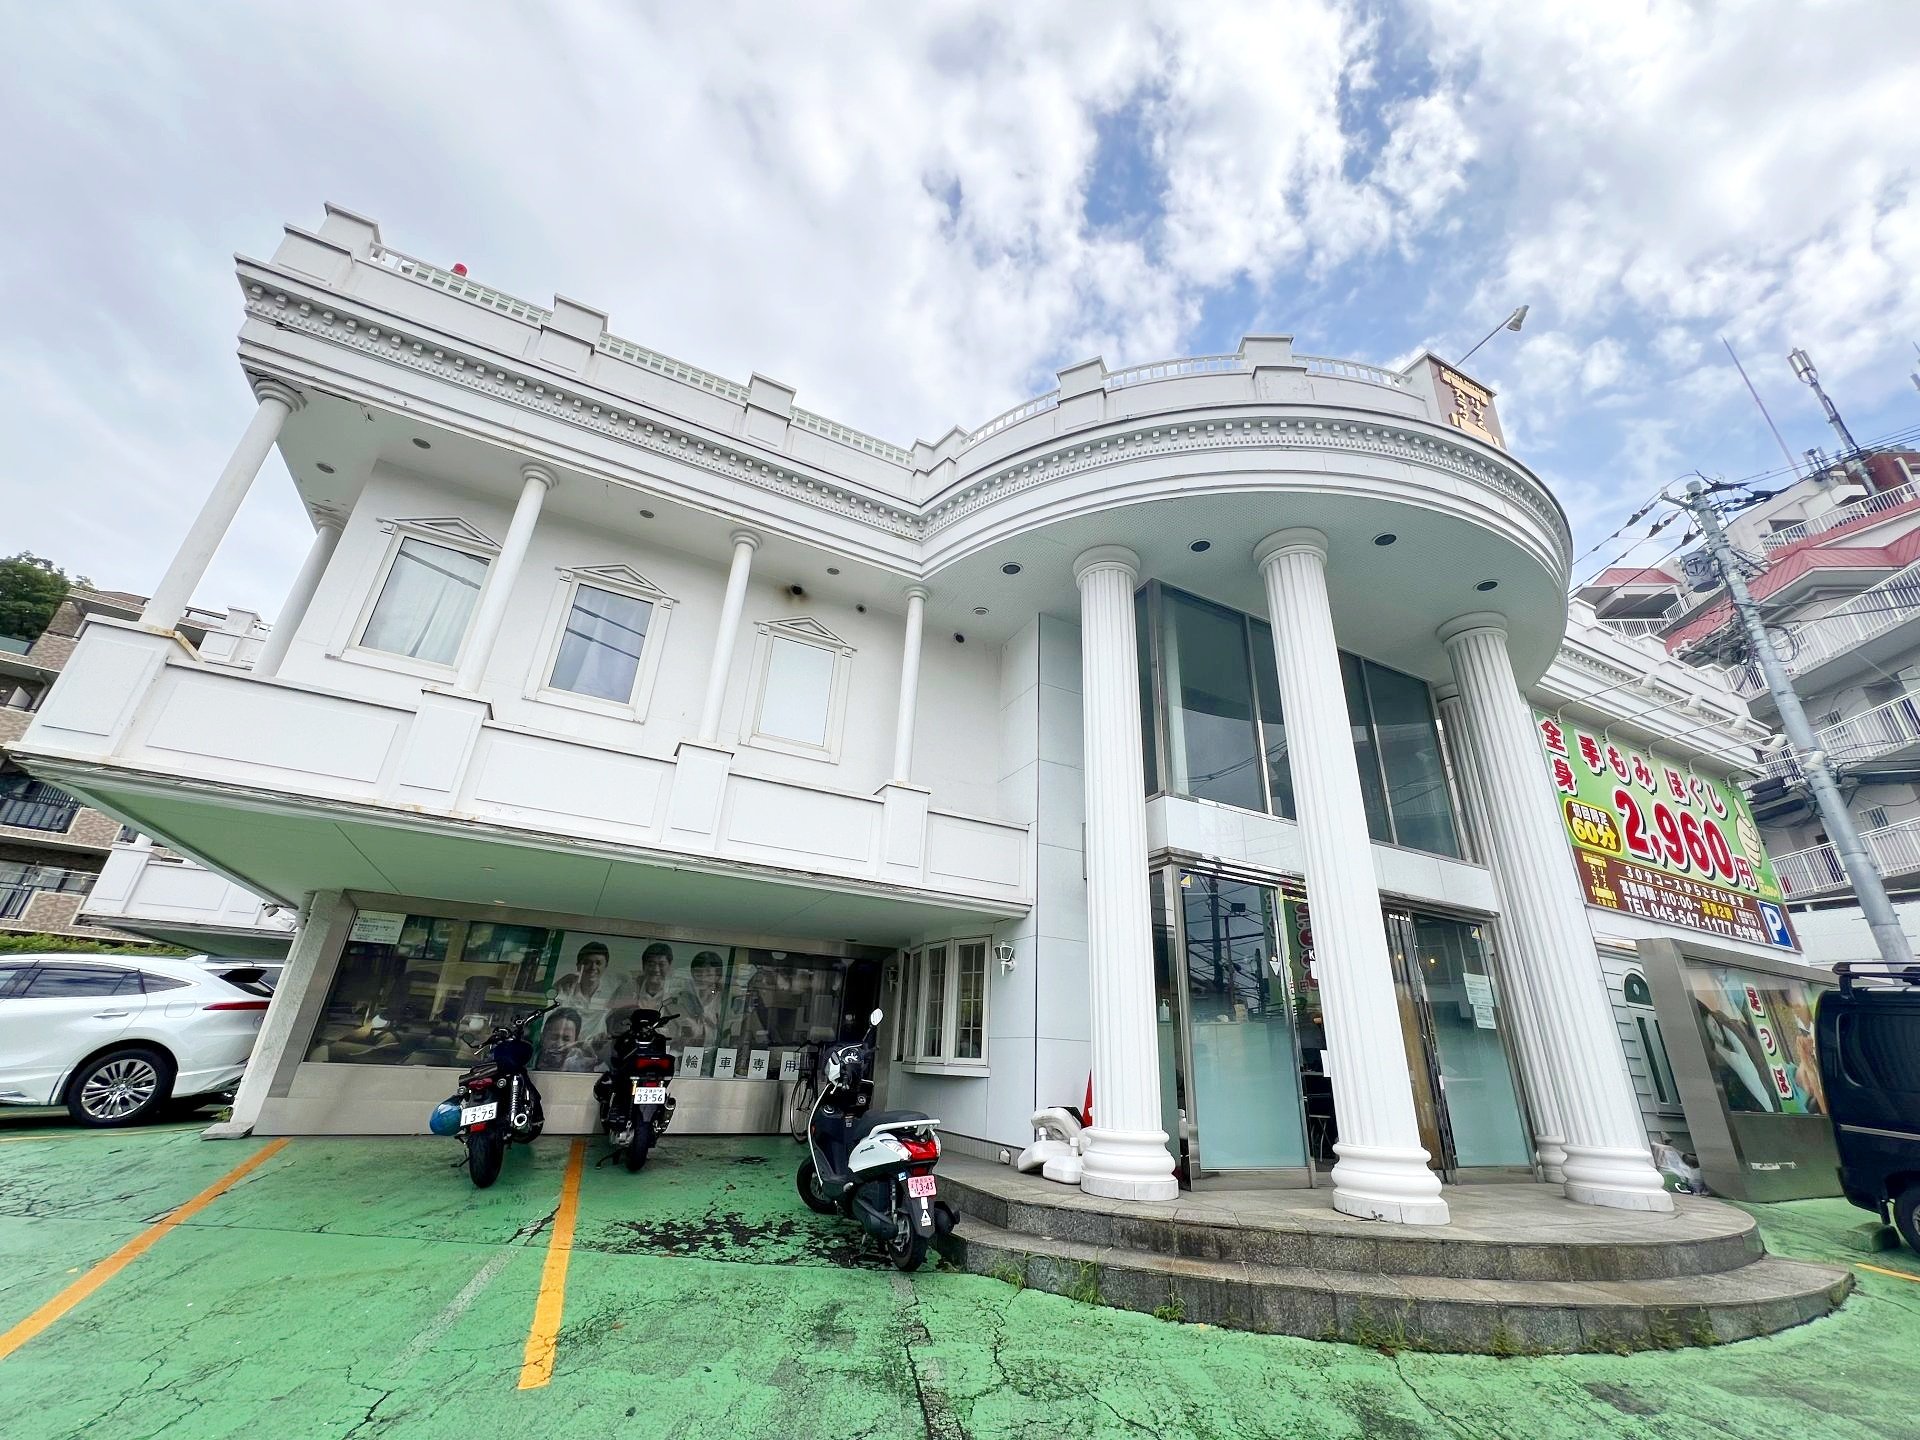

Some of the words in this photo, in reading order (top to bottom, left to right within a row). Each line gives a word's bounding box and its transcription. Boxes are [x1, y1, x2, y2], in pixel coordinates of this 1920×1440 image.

[1539, 719, 1576, 791] 全身
[1577, 733, 1725, 814] 手もみほぐし
[1571, 801, 1610, 827] 初回限定
[1572, 816, 1617, 850] 60分
[1624, 896, 1650, 917] TEL
[1650, 902, 1732, 936] 045-547-1177
[1762, 906, 1783, 942] P
